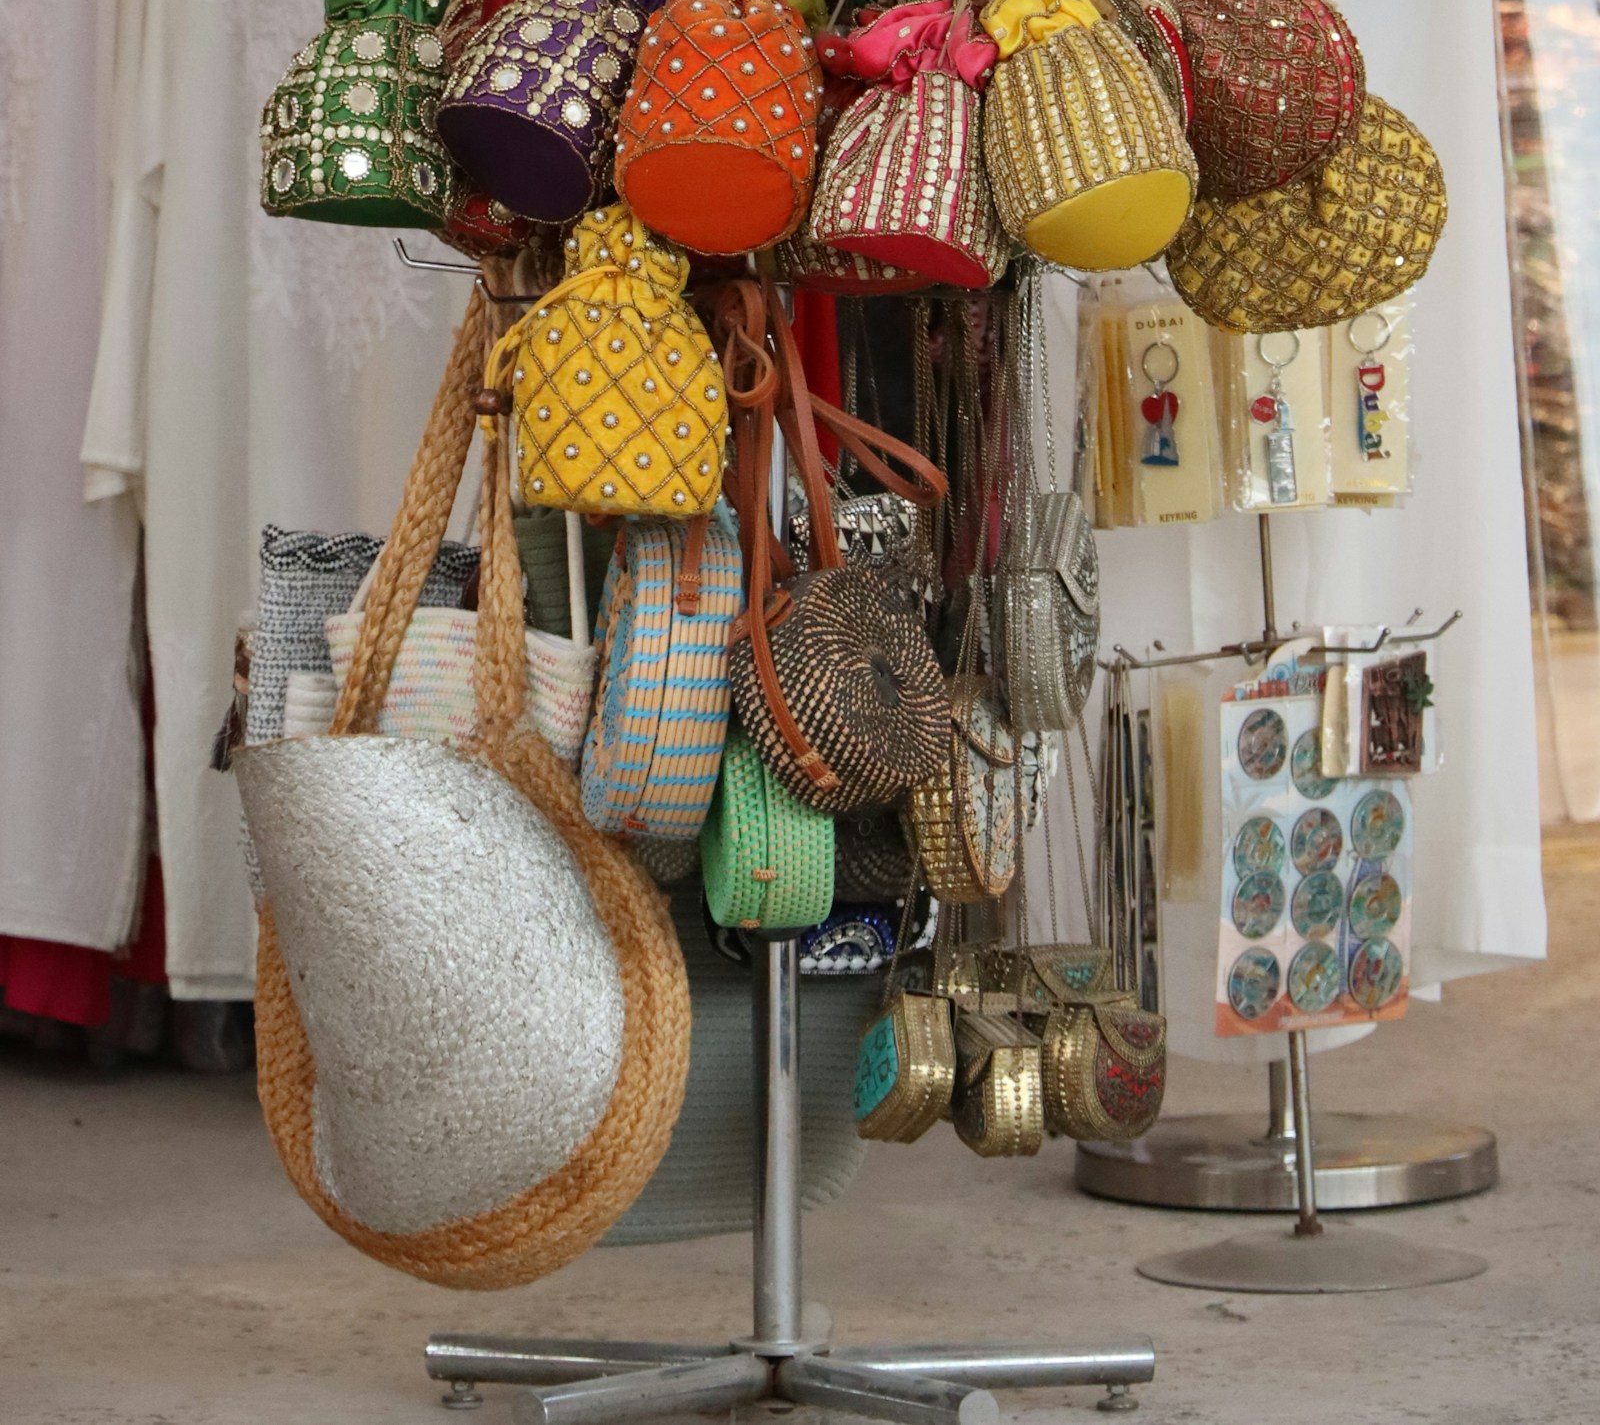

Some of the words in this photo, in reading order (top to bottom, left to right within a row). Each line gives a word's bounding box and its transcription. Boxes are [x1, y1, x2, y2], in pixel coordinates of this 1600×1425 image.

[1135, 316, 1184, 330] DUBAI
[1358, 363, 1391, 461] Dubai
[1337, 494, 1378, 505] KEYRING
[1159, 510, 1198, 522] KEYRING
